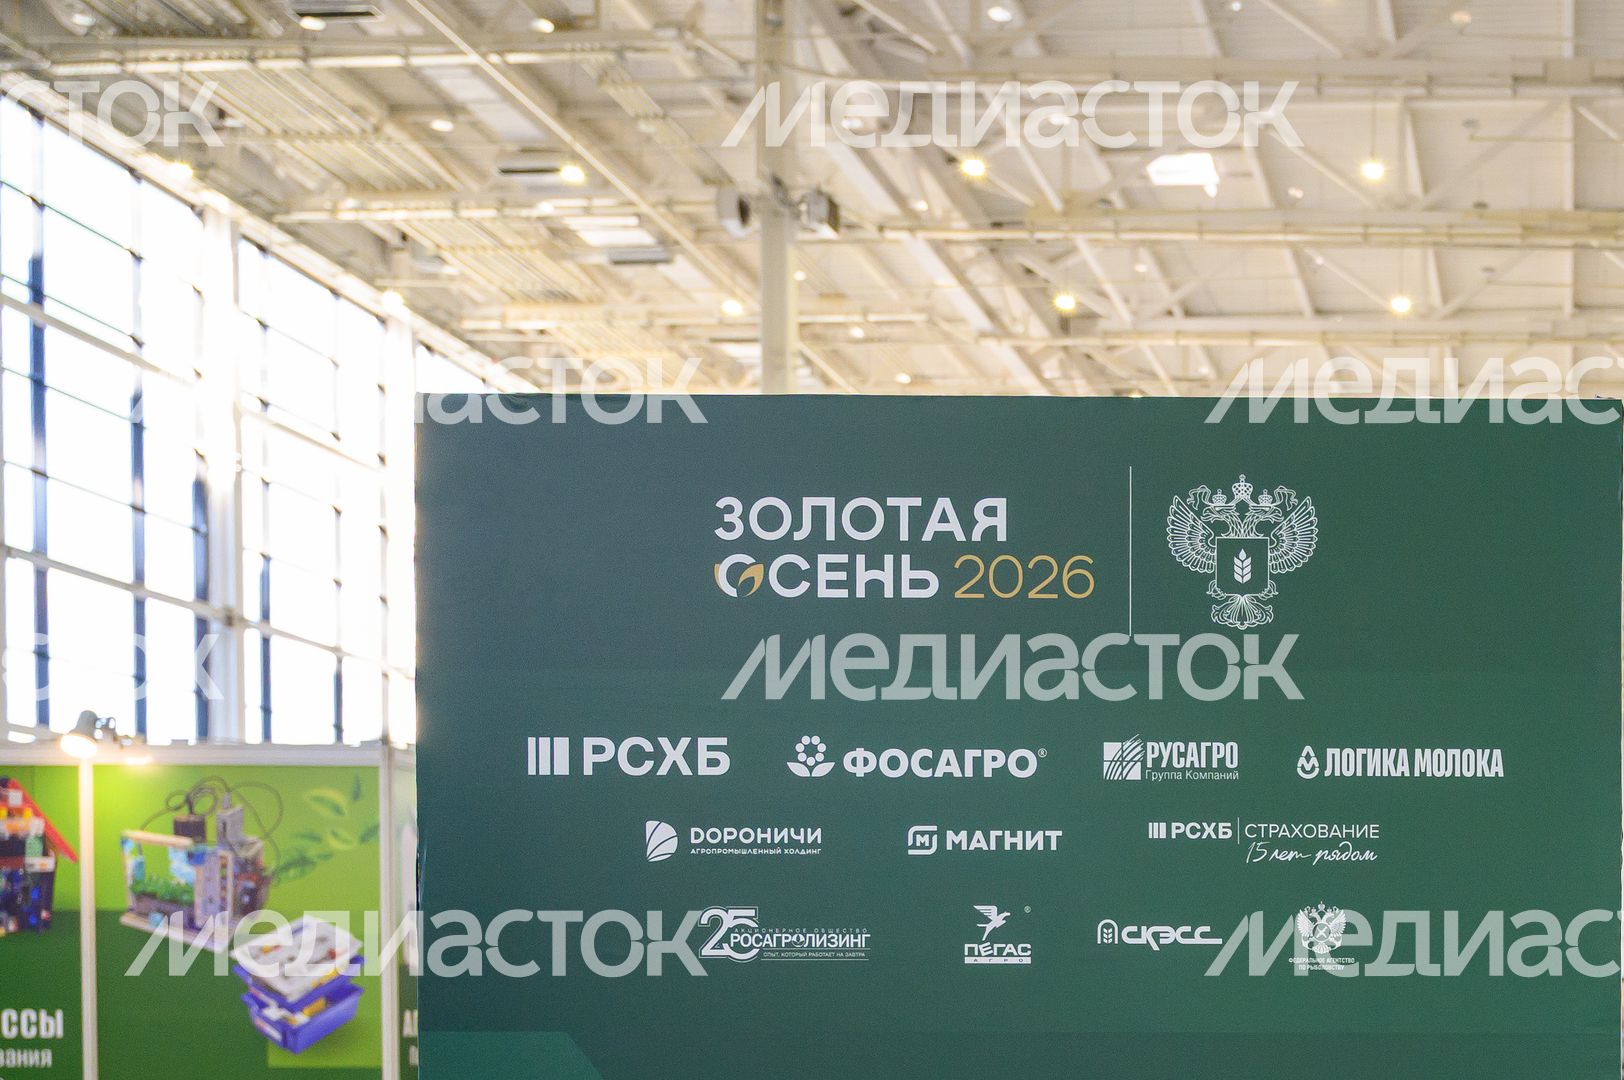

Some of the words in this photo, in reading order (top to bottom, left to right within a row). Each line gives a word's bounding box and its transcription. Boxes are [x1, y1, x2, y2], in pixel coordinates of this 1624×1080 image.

[714, 496, 1007, 541] ЗОЛОТАЯ
[714, 553, 940, 598] ОСЕНЬ
[953, 554, 1095, 599] 2026
[583, 737, 731, 776] РСХБ
[1145, 741, 1239, 768] РУСАГРО
[1324, 748, 1410, 777] ЛОГИКА
[1413, 748, 1505, 777] МОЛОКА
[1145, 769, 1183, 782] Группа
[1185, 768, 1239, 780] Компаний
[946, 830, 1063, 851] МАГНИТ
[1171, 823, 1232, 839] РСХБ
[1244, 823, 1380, 839] СТРАХОВАНИЕ
[784, 848, 822, 856] ХОЛДИНГ
[1245, 841, 1268, 864] 15
[1269, 850, 1309, 861] лет
[1312, 841, 1378, 866] рядом
[698, 906, 760, 962] 25
[730, 933, 871, 948] РОСАГРОЛИЗИНГ
[964, 942, 1032, 957] ПЕГАС
